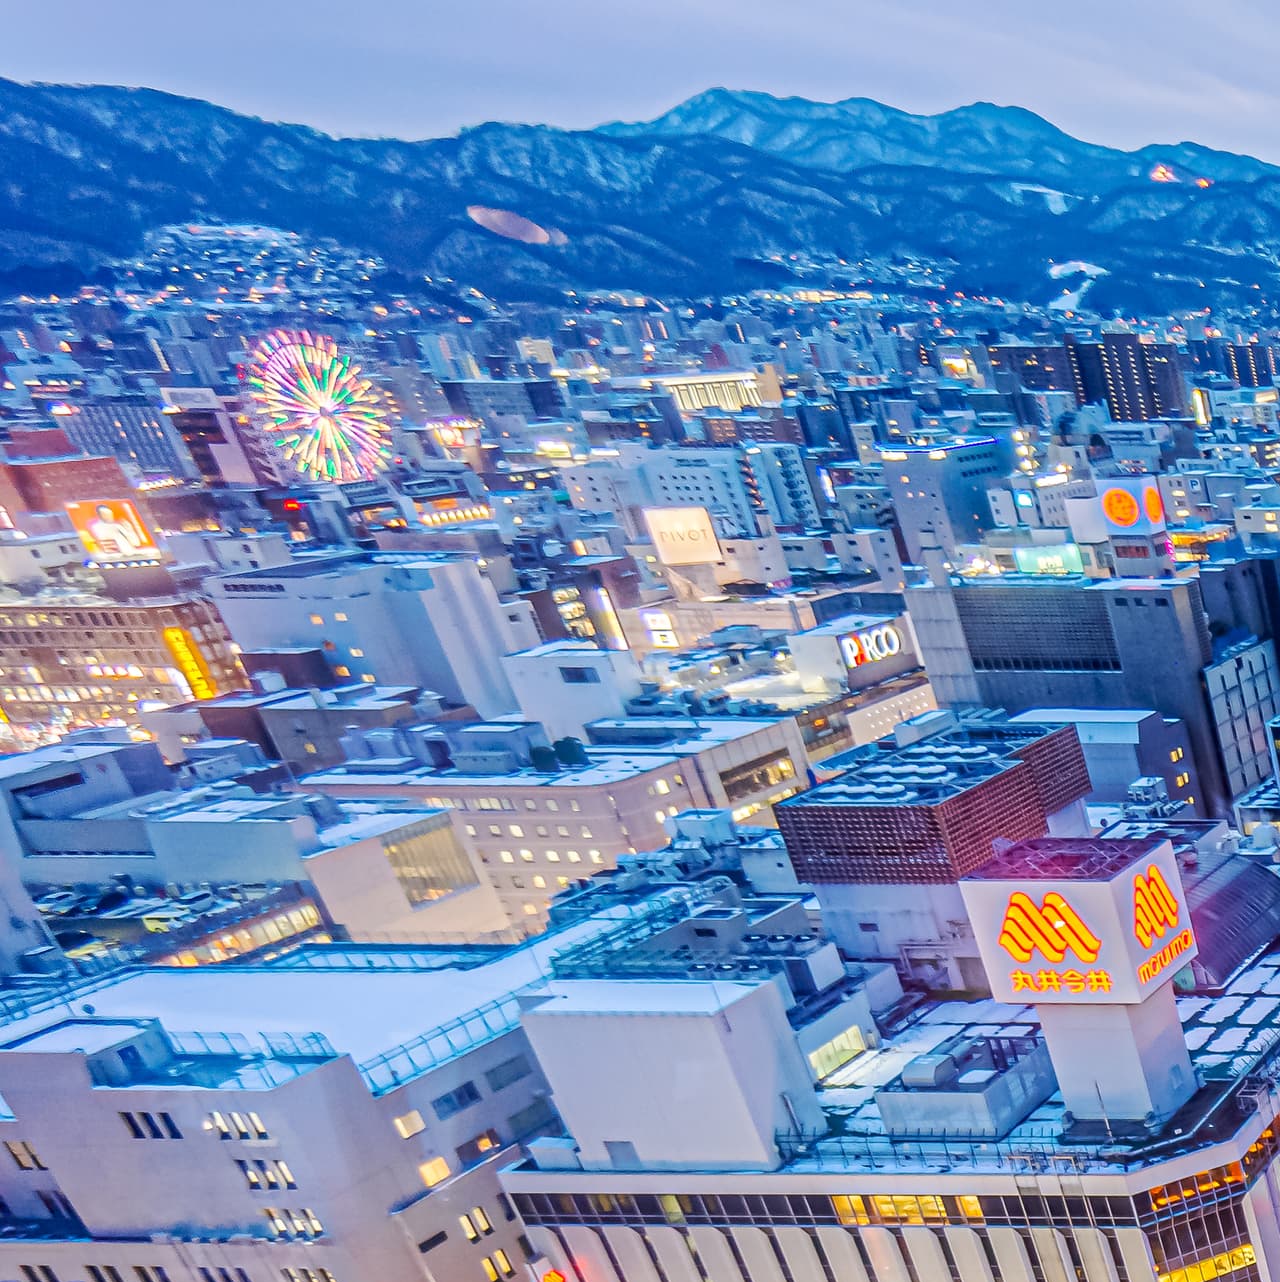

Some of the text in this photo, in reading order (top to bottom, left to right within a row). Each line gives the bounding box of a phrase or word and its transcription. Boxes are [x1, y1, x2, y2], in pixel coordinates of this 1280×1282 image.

[1190, 480, 1199, 489] P
[659, 528, 708, 543] PIVOT
[841, 626, 901, 669] PARCO
[1010, 968, 1113, 993] 丸井今井
